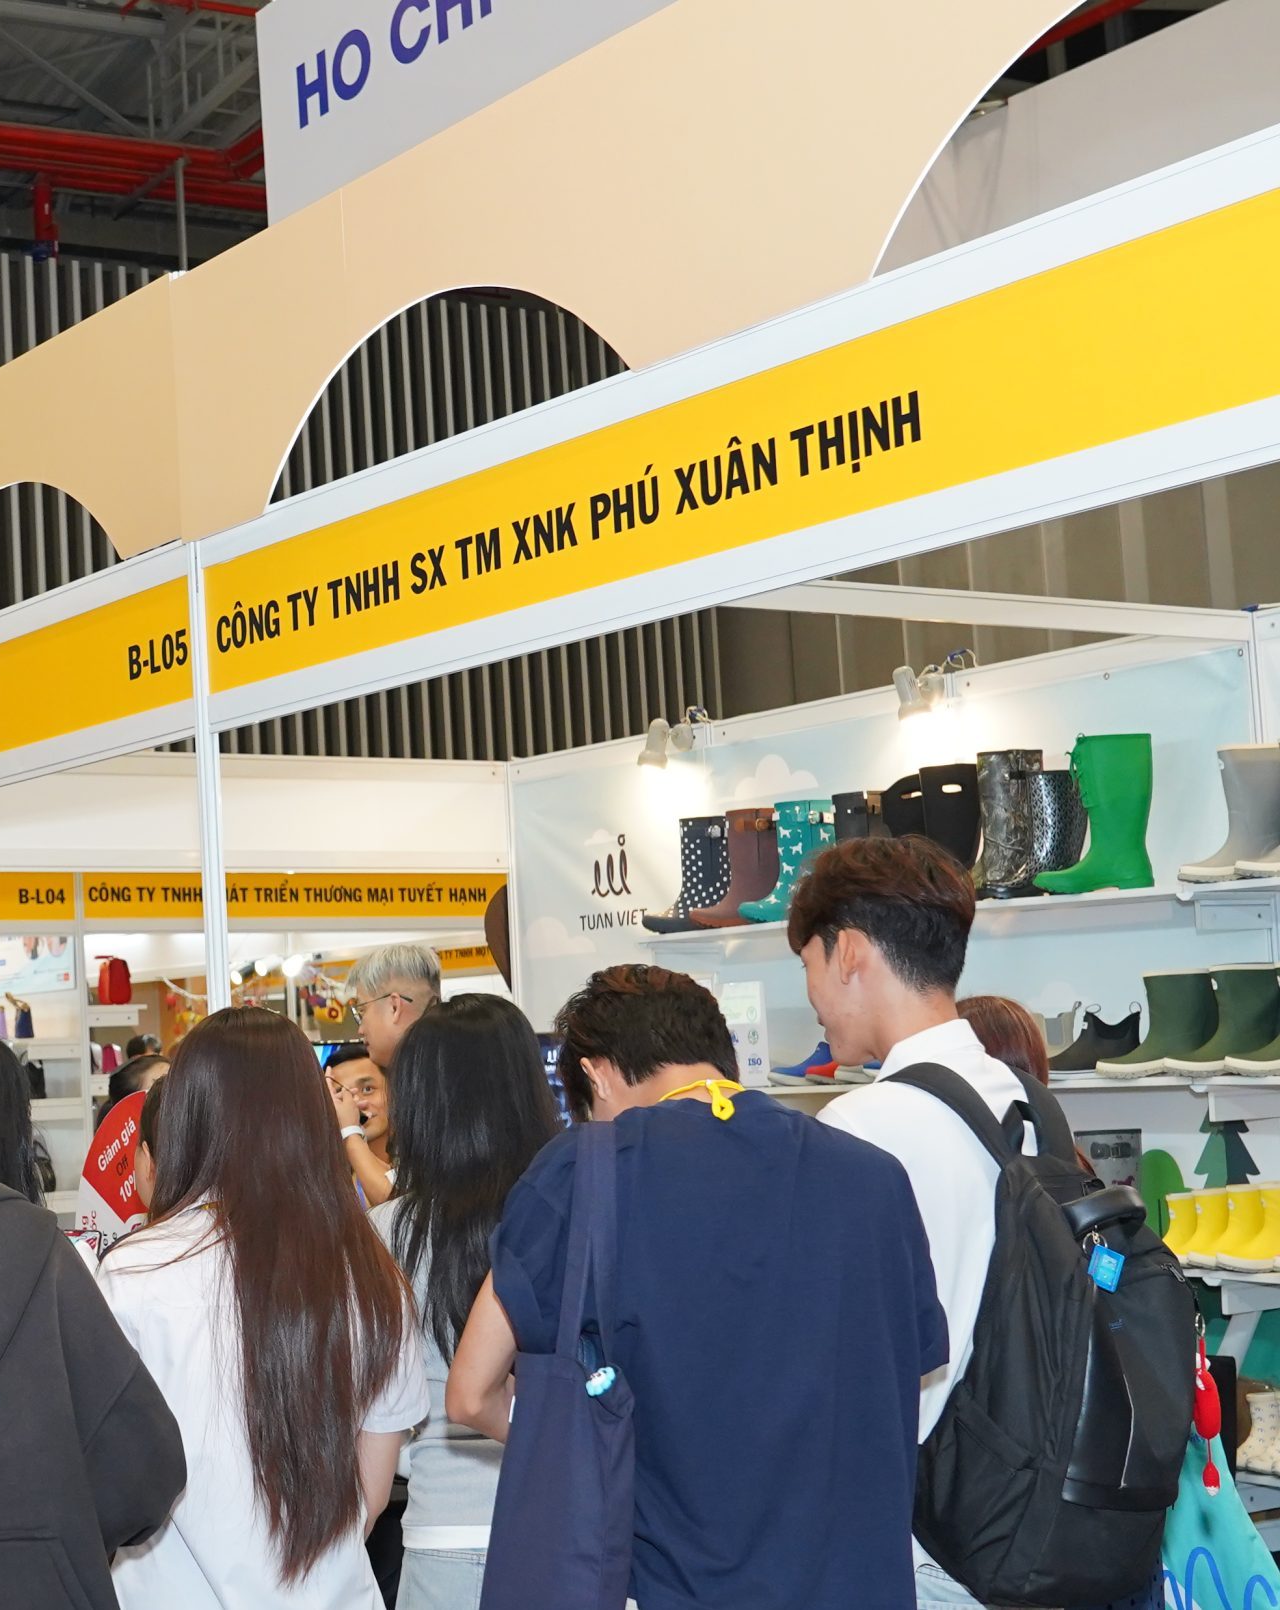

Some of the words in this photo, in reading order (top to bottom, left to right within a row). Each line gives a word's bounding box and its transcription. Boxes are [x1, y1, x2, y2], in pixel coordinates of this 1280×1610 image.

[296, 29, 371, 129] HO
[390, 0, 492, 64] CH
[217, 601, 280, 653] CÔNG
[287, 586, 318, 631] TY
[327, 560, 400, 619] TNHH
[410, 545, 447, 594] SX
[455, 527, 501, 580] TM
[511, 502, 577, 564] XNK
[590, 464, 659, 540] PHÚ
[675, 436, 778, 515] XUÂN
[790, 390, 922, 477] THỊNH
[129, 628, 188, 680] B-L05
[18, 888, 66, 905] B-L04
[88, 882, 132, 902] CÔNG
[136, 887, 156, 902] TY
[161, 887, 203, 902] TNHH
[254, 879, 299, 903] TRIỂN
[304, 884, 362, 903] THƯƠNG
[367, 888, 394, 906] MẠI
[398, 881, 444, 903] TUYẾT
[449, 888, 487, 906] HẠNH
[580, 911, 613, 931] TUAN
[617, 908, 648, 927] VIET
[97, 1138, 121, 1172] Giảm
[121, 1117, 137, 1147] giá
[116, 1153, 129, 1177] Off
